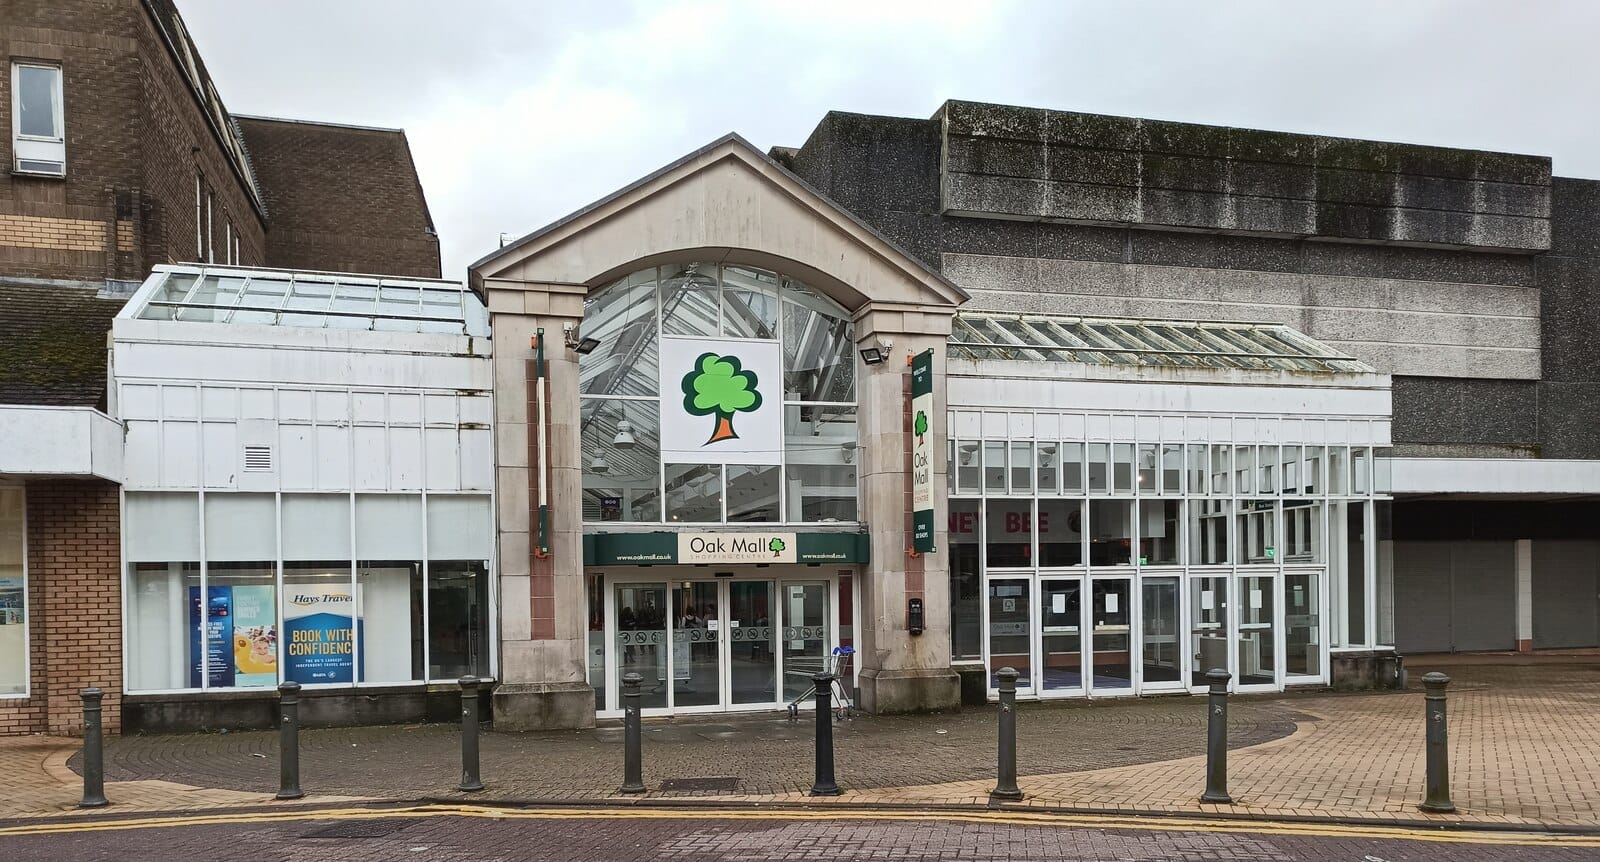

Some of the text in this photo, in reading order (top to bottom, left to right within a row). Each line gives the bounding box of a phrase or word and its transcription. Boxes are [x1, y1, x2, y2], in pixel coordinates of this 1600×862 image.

[914, 451, 928, 469] Oak
[914, 468, 929, 485] Mall
[1006, 511, 1049, 533] BEE
[690, 537, 766, 553] Oak Mall
[616, 553, 672, 561] www.oakmall.co.uk
[294, 594, 320, 604] Hays
[292, 628, 353, 642] BOOK WITH
[289, 641, 353, 656] CONFIDENC
